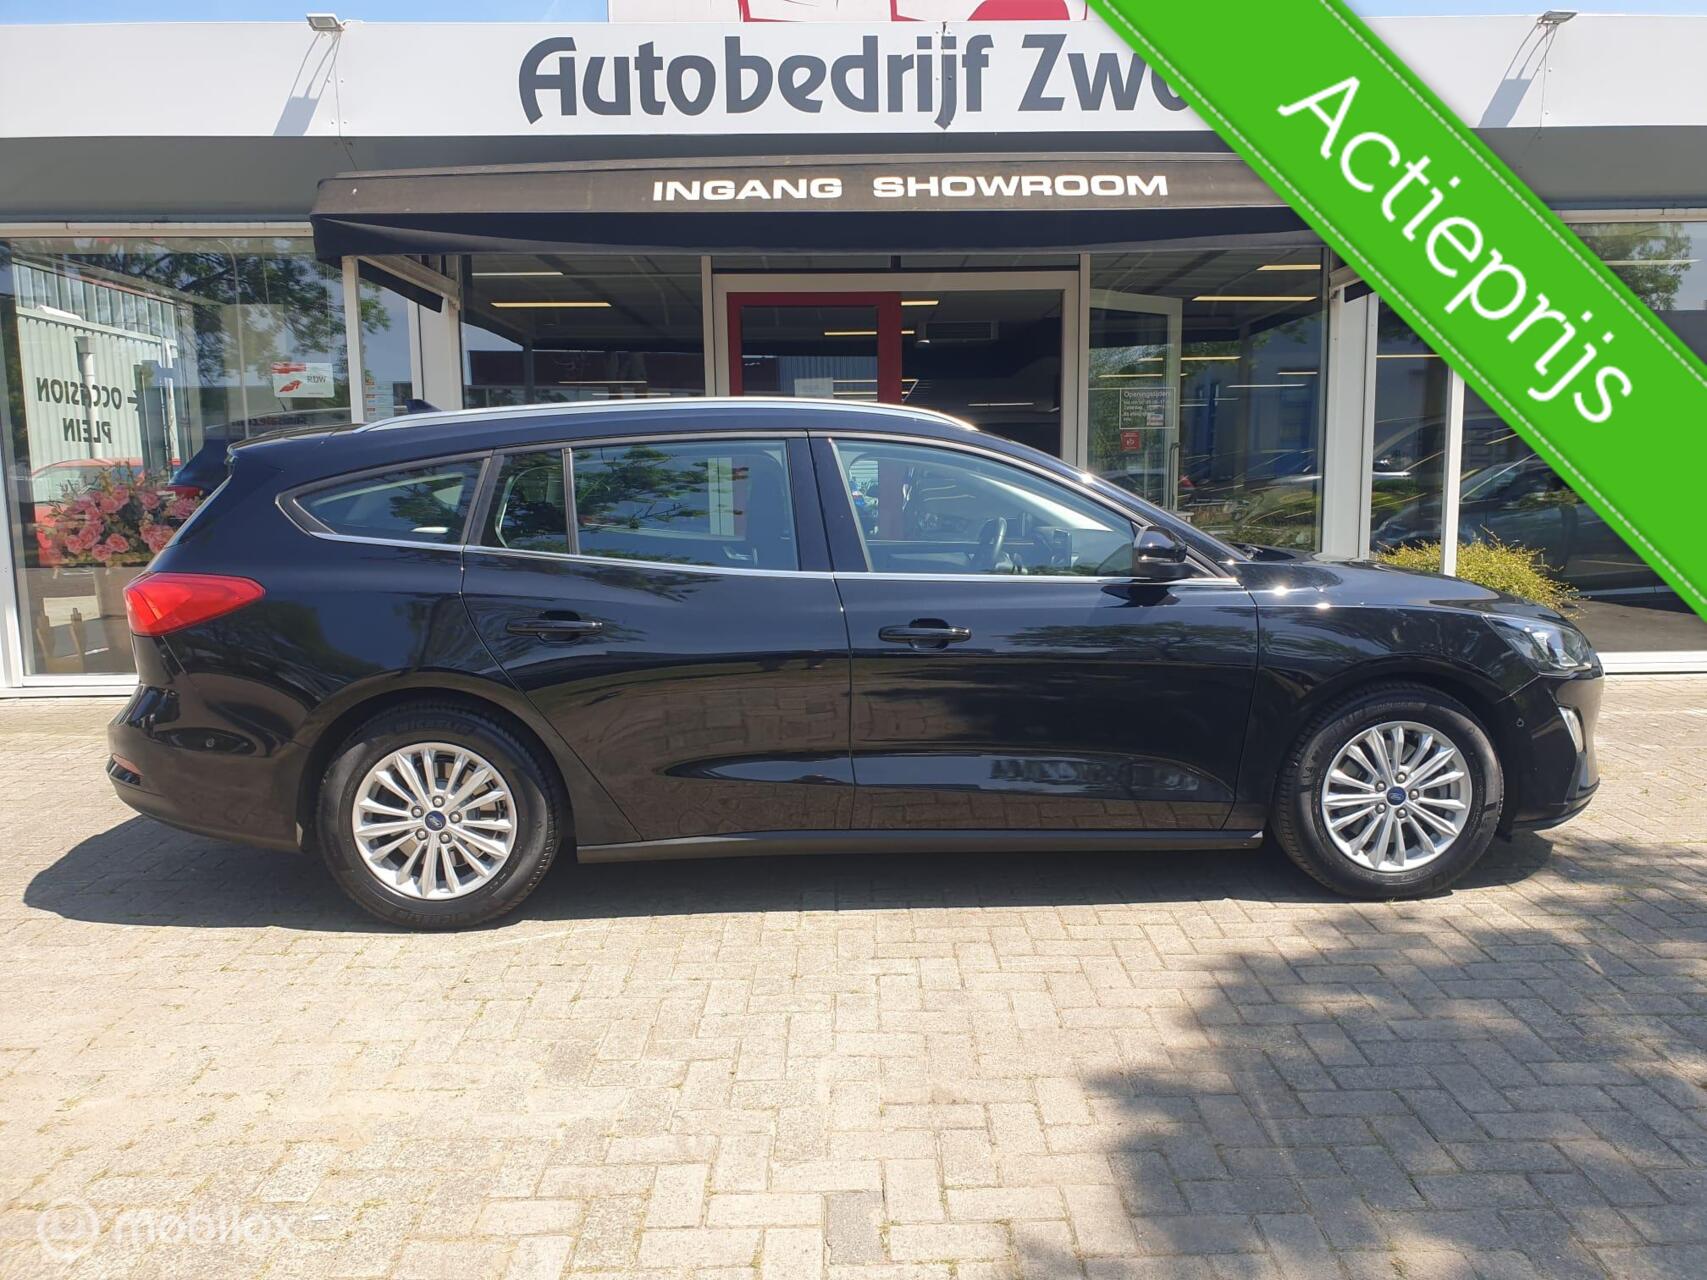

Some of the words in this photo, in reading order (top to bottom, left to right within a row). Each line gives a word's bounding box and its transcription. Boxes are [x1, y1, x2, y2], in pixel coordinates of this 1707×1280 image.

[519, 34, 993, 131] Autobedrijf
[652, 177, 843, 202] INGANG
[872, 174, 1169, 199] SHOWROOM
